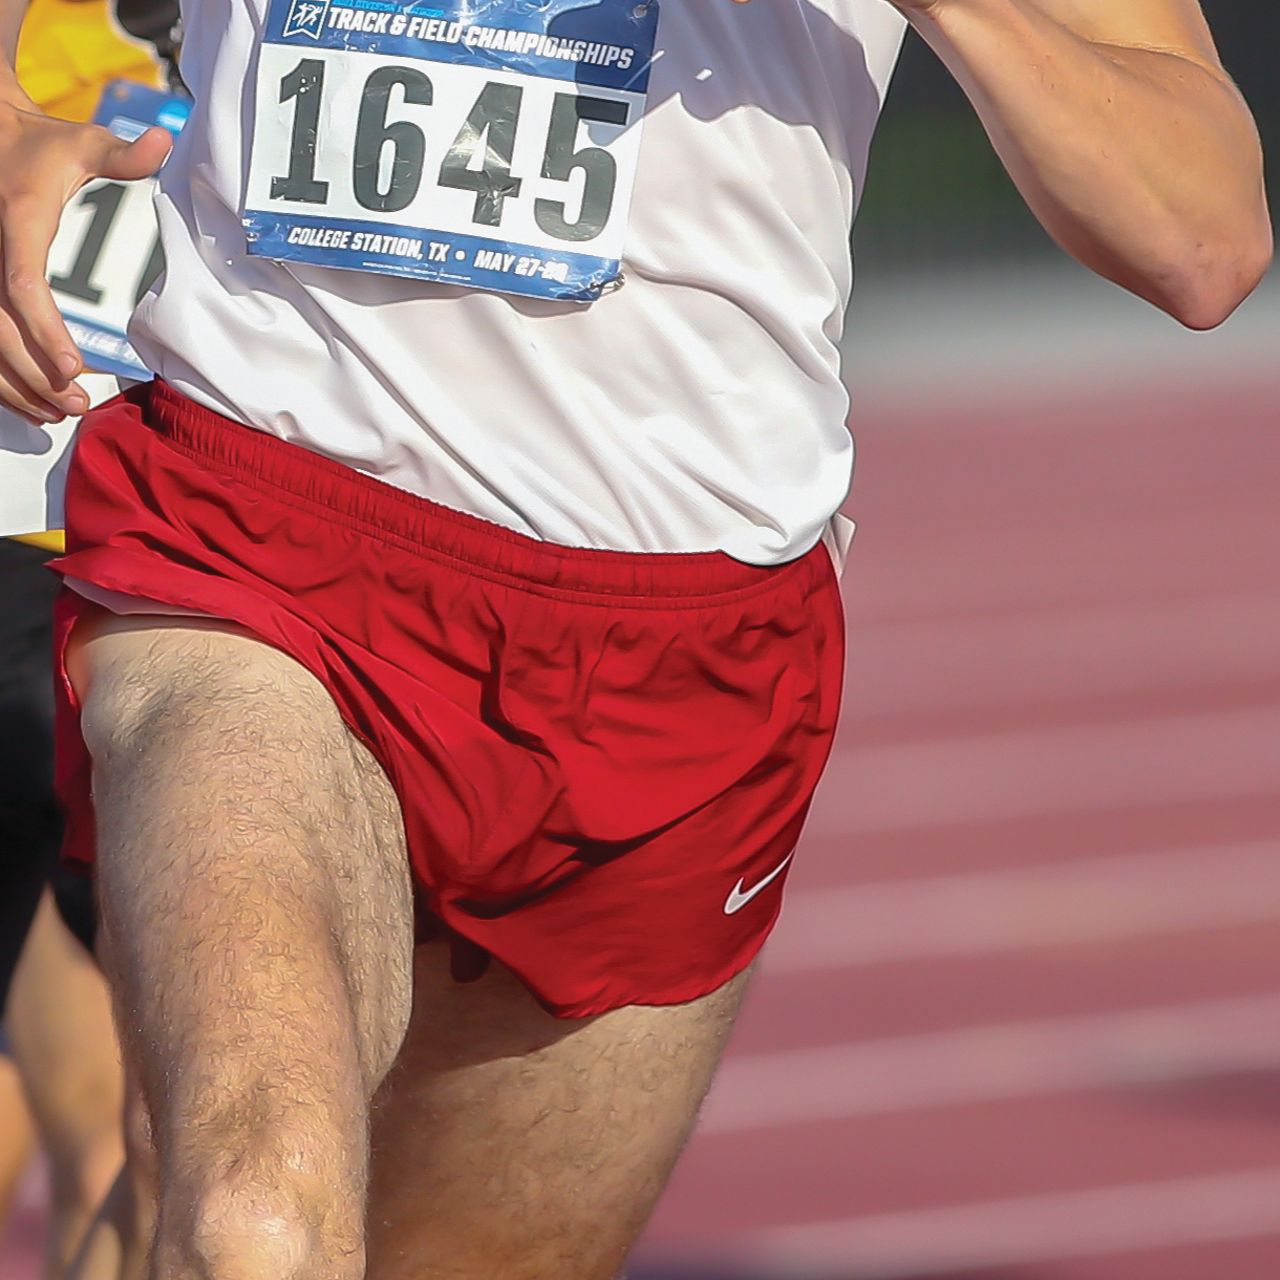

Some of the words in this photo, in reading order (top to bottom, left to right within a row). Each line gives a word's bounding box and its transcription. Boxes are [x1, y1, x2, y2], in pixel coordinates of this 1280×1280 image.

[327, 6, 393, 35] TRACK
[389, 13, 408, 37] &
[406, 16, 463, 44] FIELD
[465, 24, 635, 70] CHAMPIONSHIPS
[269, 58, 631, 243] 1645
[287, 226, 352, 250] COLLEGE
[351, 232, 424, 260] STATION,
[428, 241, 451, 262] TX
[473, 249, 516, 273] MAY
